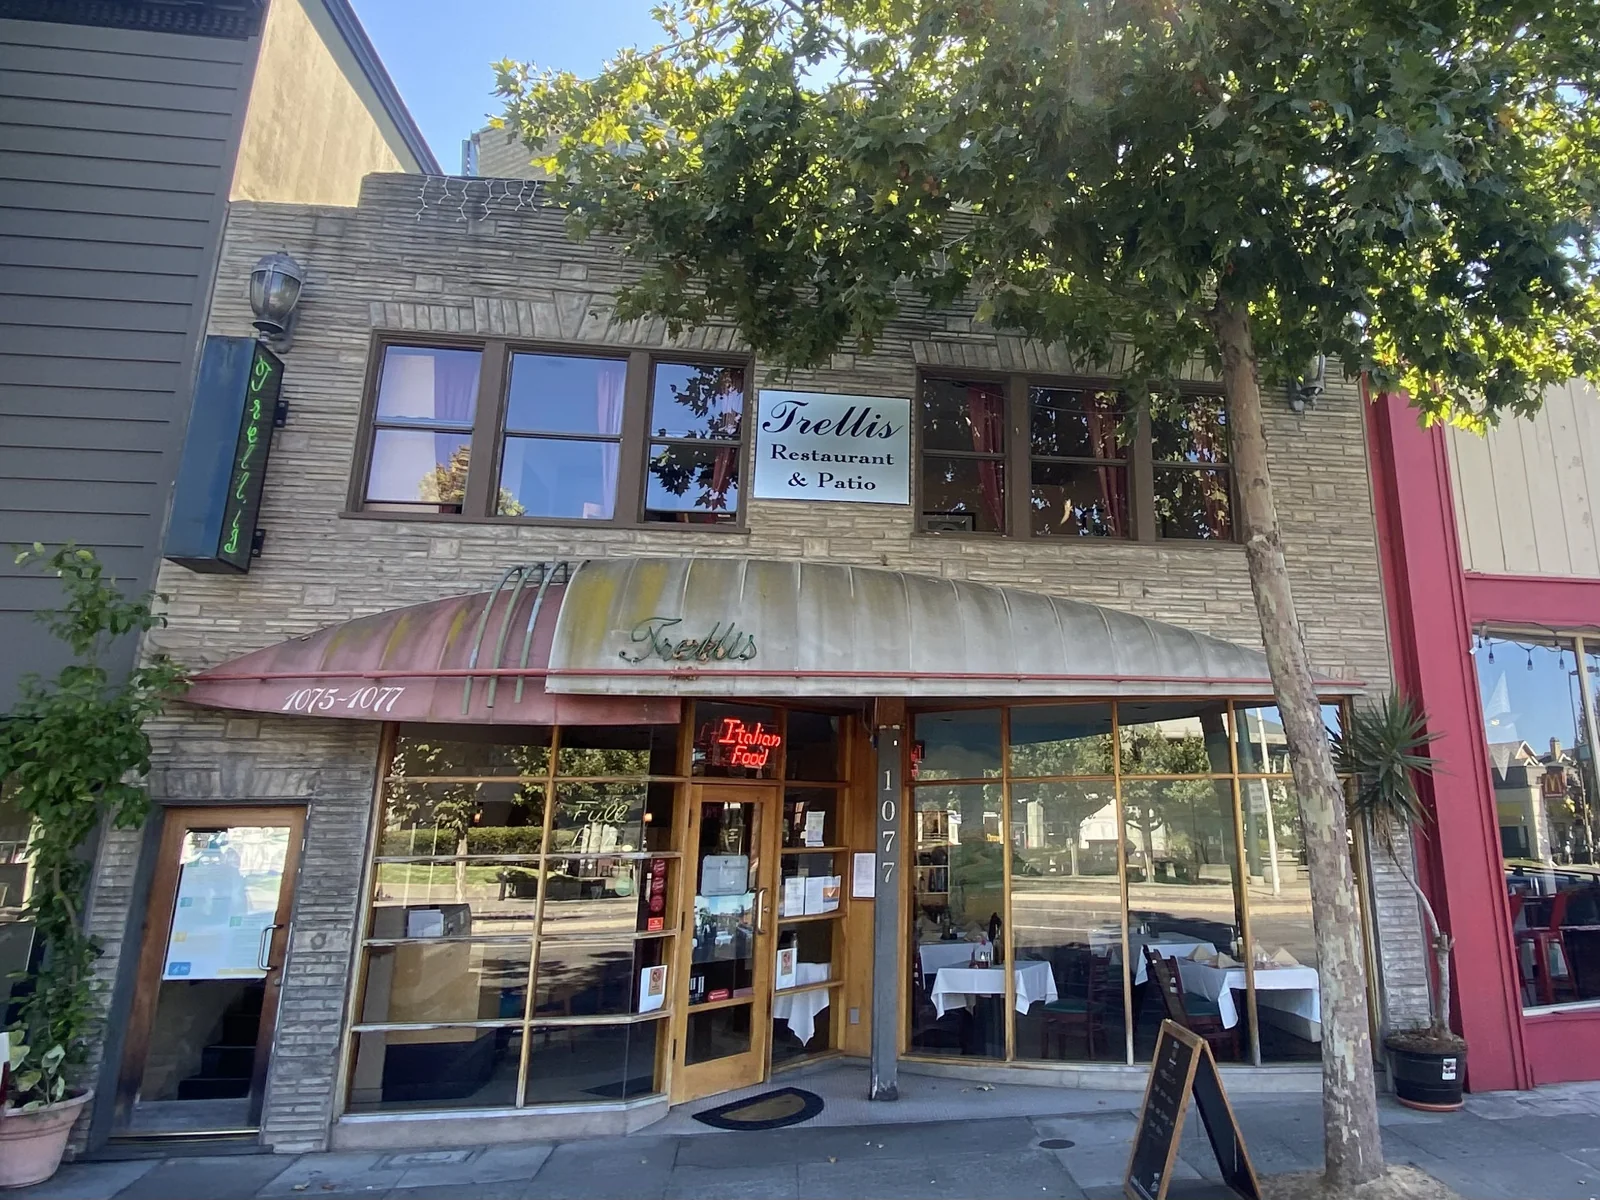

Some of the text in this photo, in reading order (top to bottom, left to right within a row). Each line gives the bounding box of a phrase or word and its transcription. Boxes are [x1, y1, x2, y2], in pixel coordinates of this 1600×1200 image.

[762, 400, 904, 439] Trellis
[770, 443, 895, 465] Restaurant
[788, 471, 876, 490] & Patio
[619, 617, 757, 664] Trellis
[282, 686, 405, 713] 1075-1077
[718, 718, 781, 747] Italian
[731, 745, 769, 766] Food
[573, 800, 628, 823] Full
[881, 770, 896, 883] 1077
